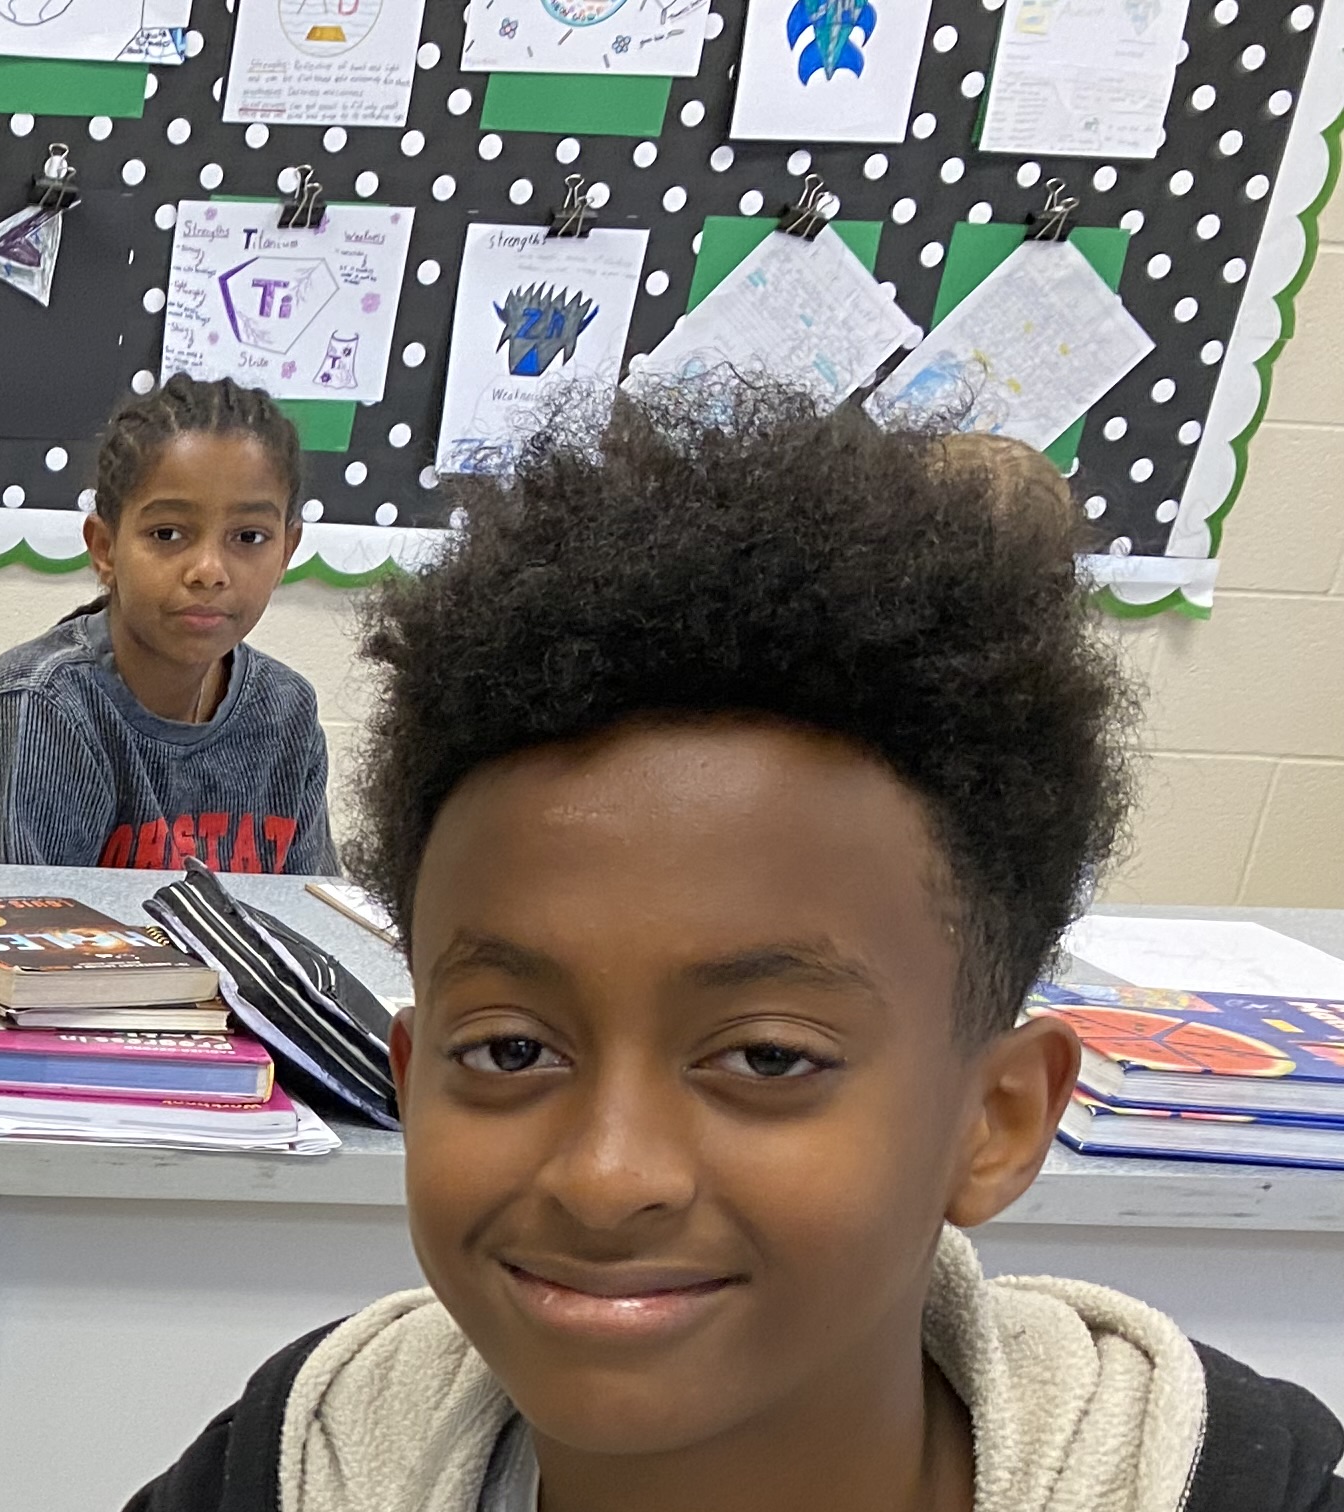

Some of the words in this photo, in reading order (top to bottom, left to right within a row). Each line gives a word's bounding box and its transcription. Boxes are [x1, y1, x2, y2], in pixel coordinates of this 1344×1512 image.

[251, 278, 294, 319] Ti
[514, 307, 566, 340] Zn
[59, 1034, 88, 1044] in
[96, 1036, 233, 1051] Progress
[161, 1099, 262, 1110] Workbook
